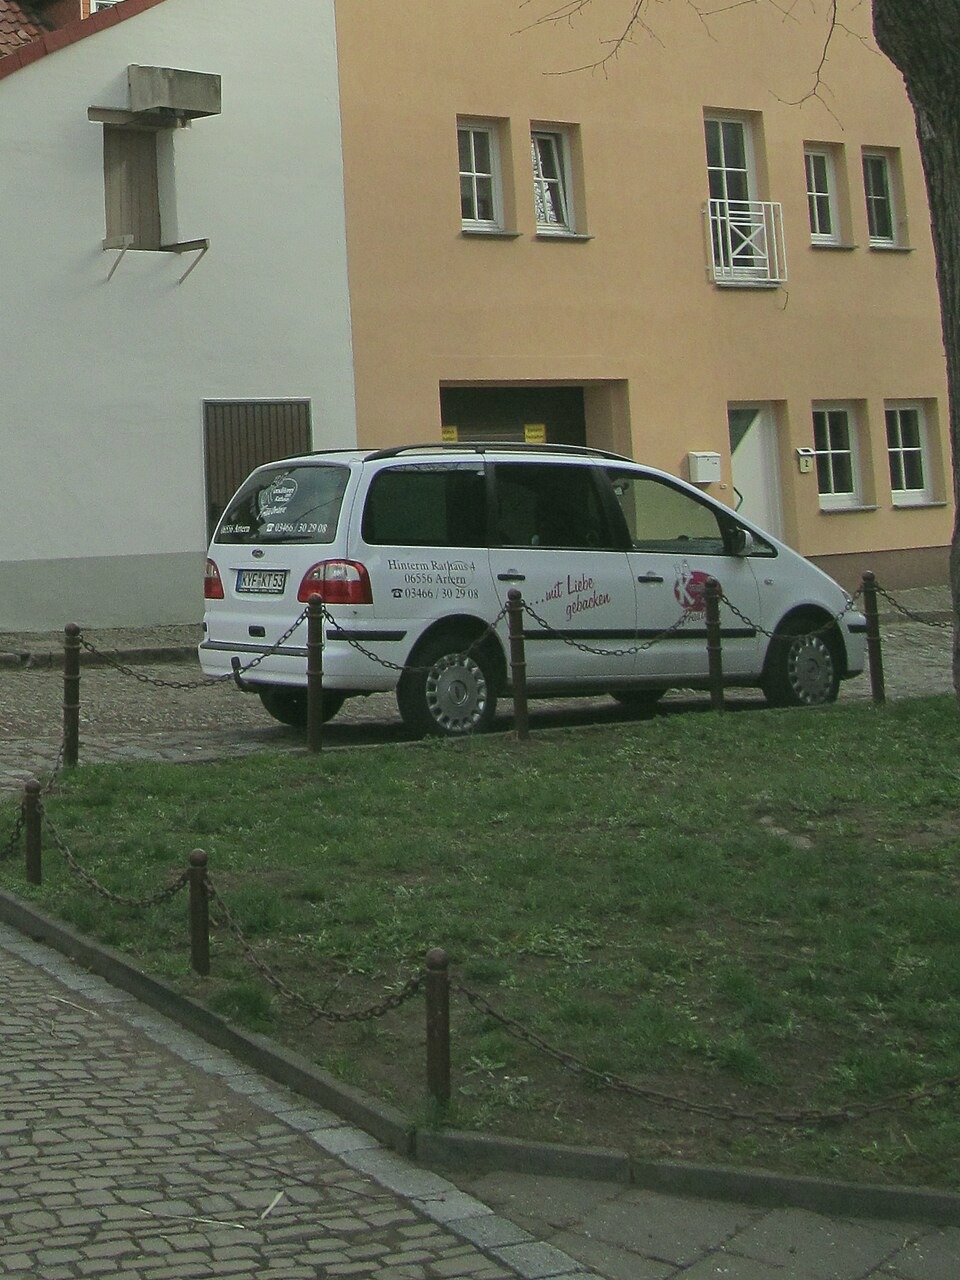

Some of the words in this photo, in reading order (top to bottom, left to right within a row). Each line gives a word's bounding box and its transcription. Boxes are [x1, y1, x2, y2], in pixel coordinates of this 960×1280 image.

[298, 523, 307, 533] 30
[318, 524, 327, 533] 08
[387, 559, 429, 570] Hinterm
[431, 560, 468, 571] Rathaus
[470, 561, 476, 571] 4
[404, 573, 433, 584] 06556
[435, 574, 466, 585] Artern
[567, 573, 594, 595] Liebe
[404, 587, 433, 599] 03466
[442, 588, 453, 599] 30
[455, 588, 466, 599] 29
[467, 589, 479, 599] 08
[565, 589, 611, 622] gebacken
